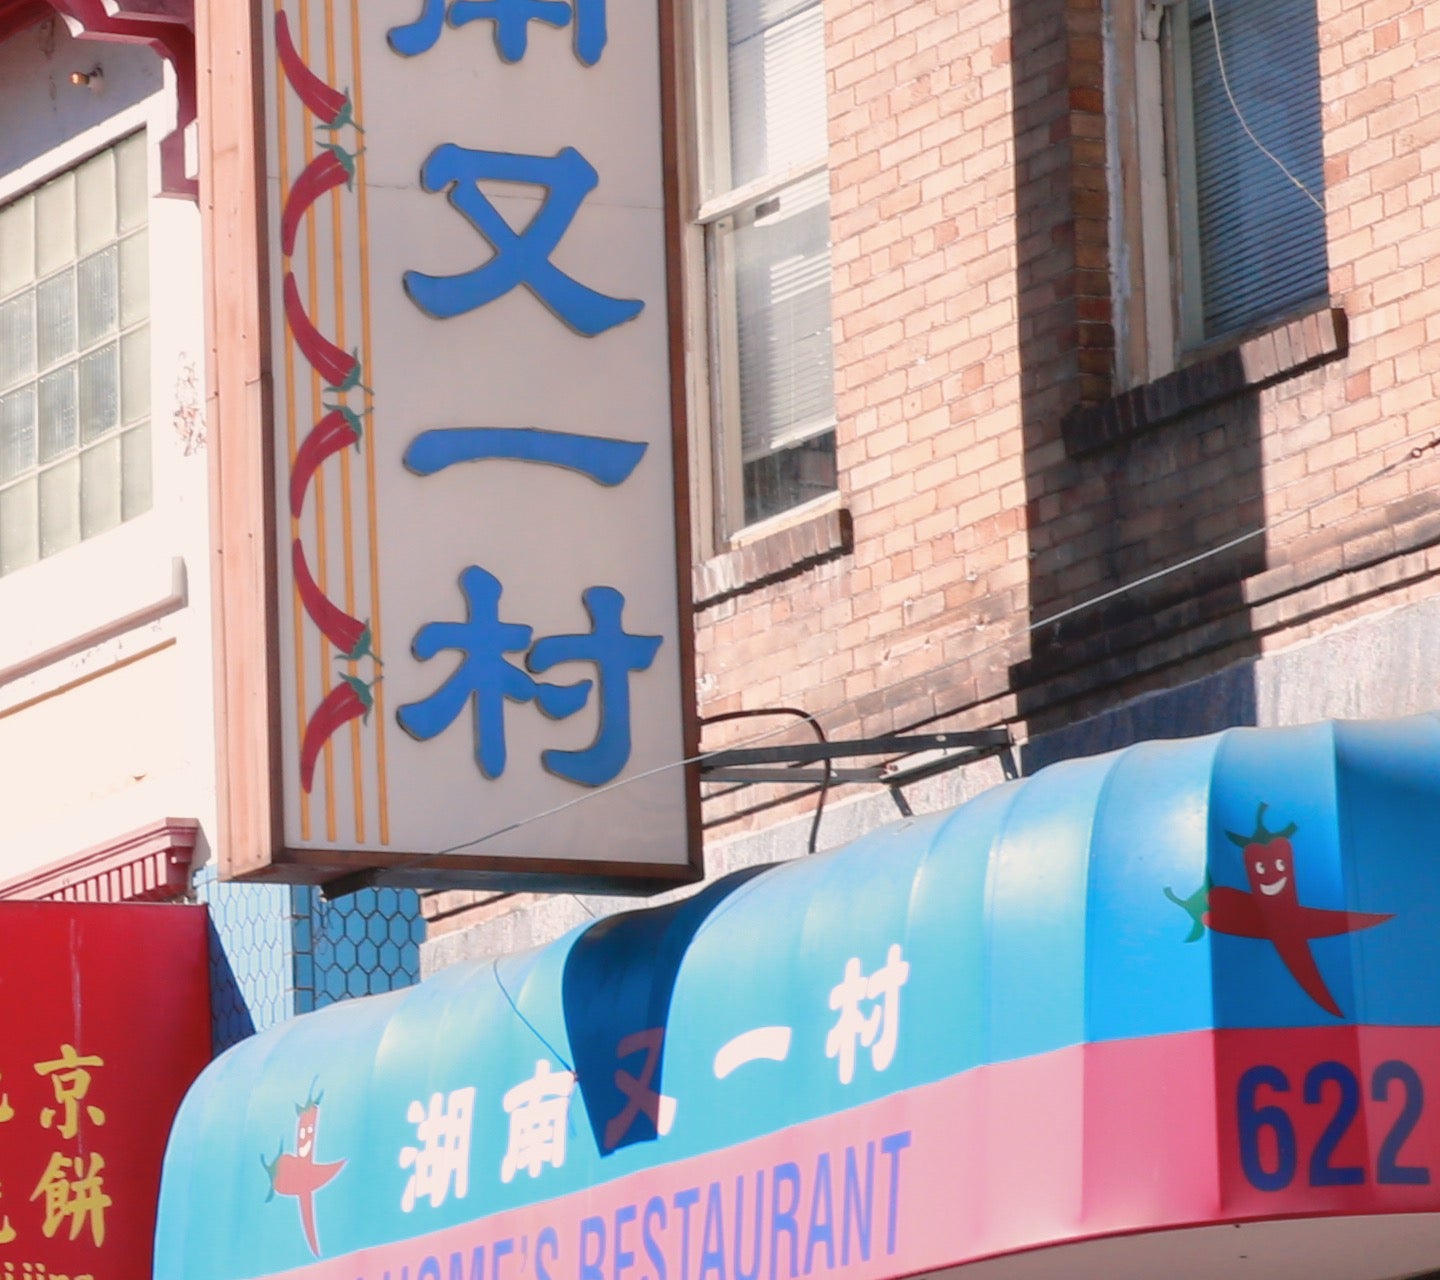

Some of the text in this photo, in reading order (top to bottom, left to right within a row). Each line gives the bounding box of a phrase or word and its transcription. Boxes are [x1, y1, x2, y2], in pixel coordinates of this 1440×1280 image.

[399, 943, 911, 1213] 湖南又一村
[1236, 1059, 1431, 1193] 622
